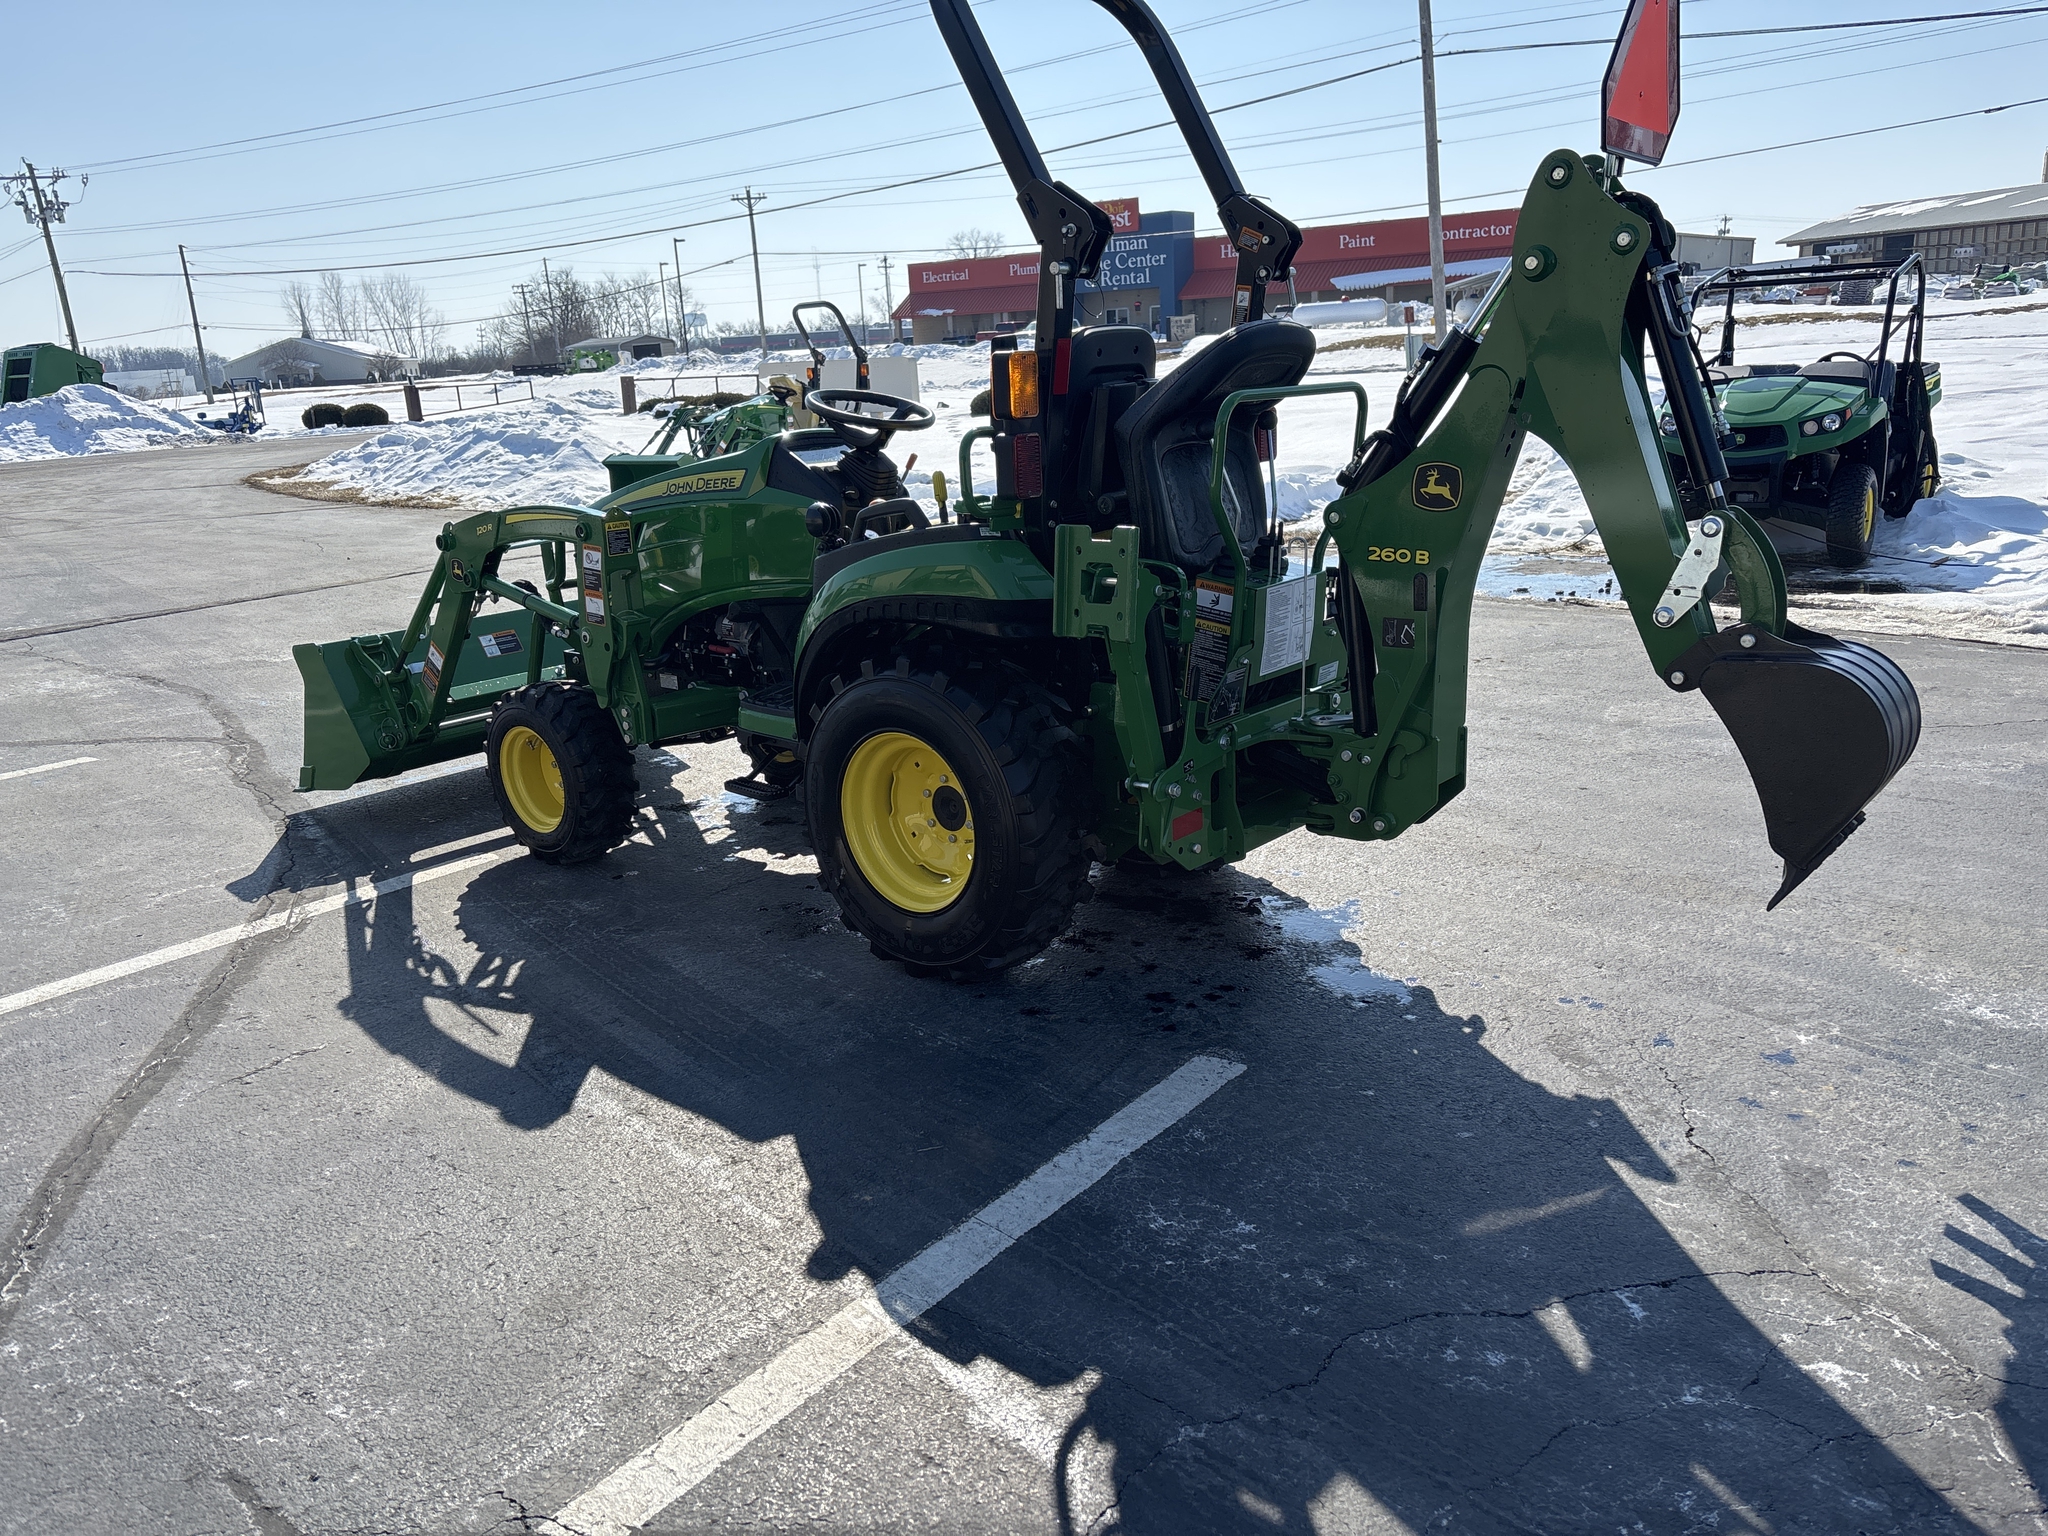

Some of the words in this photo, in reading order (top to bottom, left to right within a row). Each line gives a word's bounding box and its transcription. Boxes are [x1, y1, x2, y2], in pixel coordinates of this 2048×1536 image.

[1108, 210, 1132, 228] est
[1441, 224, 1513, 241] ontractor
[1339, 234, 1376, 249] Paint
[1115, 252, 1167, 269] Center
[922, 268, 970, 284] Electrical
[1100, 268, 1151, 287] Rental
[662, 480, 694, 496] JOHN
[695, 477, 737, 490] DEERE
[487, 523, 493, 532] R
[1367, 546, 1412, 563] 260
[1414, 549, 1430, 565] B
[1204, 582, 1233, 595] WARNING
[1201, 622, 1228, 634] CAUTION
